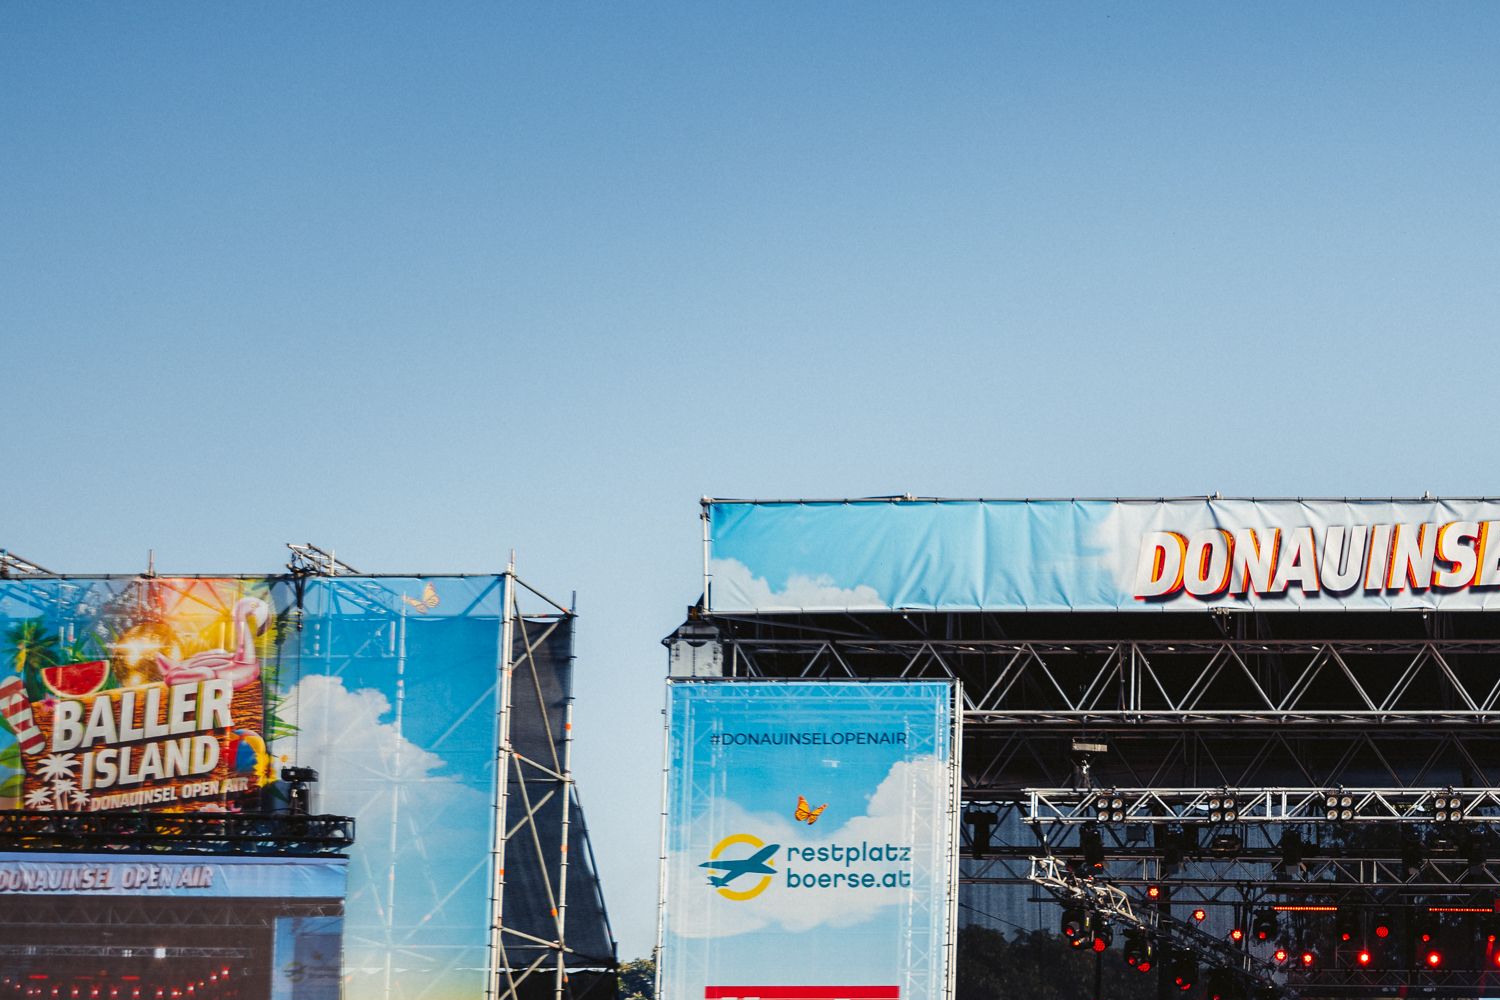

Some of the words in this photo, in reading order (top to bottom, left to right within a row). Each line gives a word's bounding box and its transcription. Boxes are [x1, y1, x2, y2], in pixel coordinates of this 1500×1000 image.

[52, 679, 235, 753] BALLER
[710, 731, 908, 746] #DONAUINSELOPENAIR
[82, 735, 221, 790] ISLAND
[90, 786, 178, 812] DONAUINSEL
[182, 780, 220, 799] OPEN
[221, 777, 249, 794] AIR
[787, 842, 911, 867] restplatz
[122, 864, 174, 885] OPEN
[176, 864, 214, 888] AIR
[787, 868, 911, 888] boerse.at
